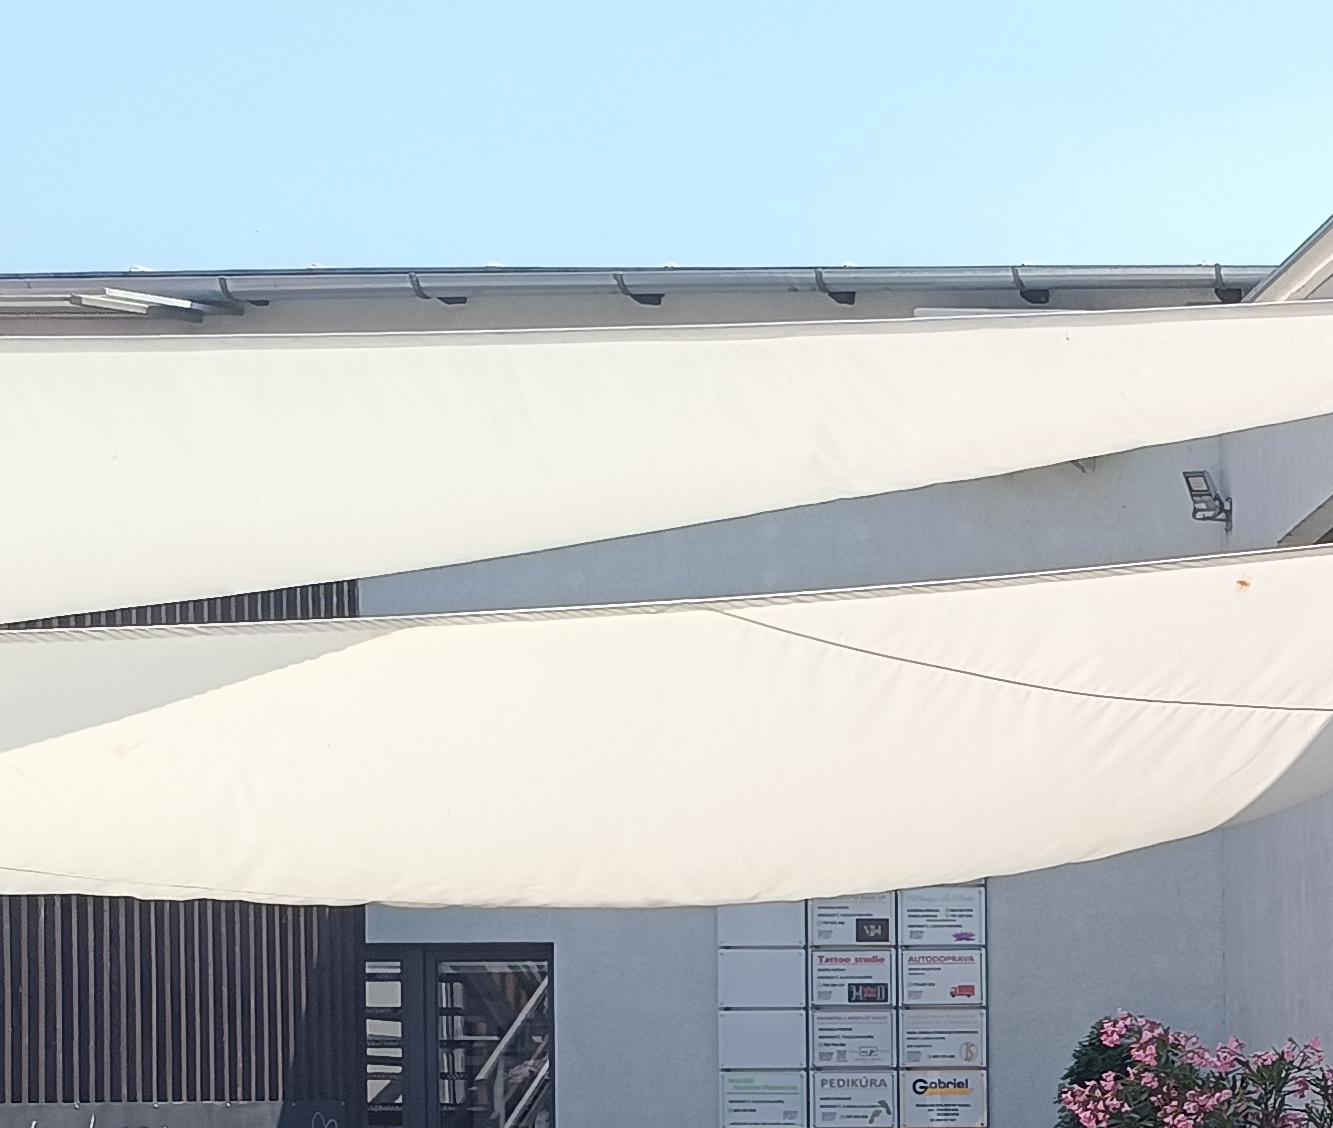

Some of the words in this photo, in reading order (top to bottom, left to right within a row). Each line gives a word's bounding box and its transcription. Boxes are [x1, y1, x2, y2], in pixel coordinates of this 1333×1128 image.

[817, 955, 851, 964] Tattoo
[854, 955, 885, 964] studio
[908, 955, 975, 963] AUTODOPRAVA
[820, 1076, 888, 1088] PEDIKÚRA
[912, 1078, 969, 1095] Gabriel
